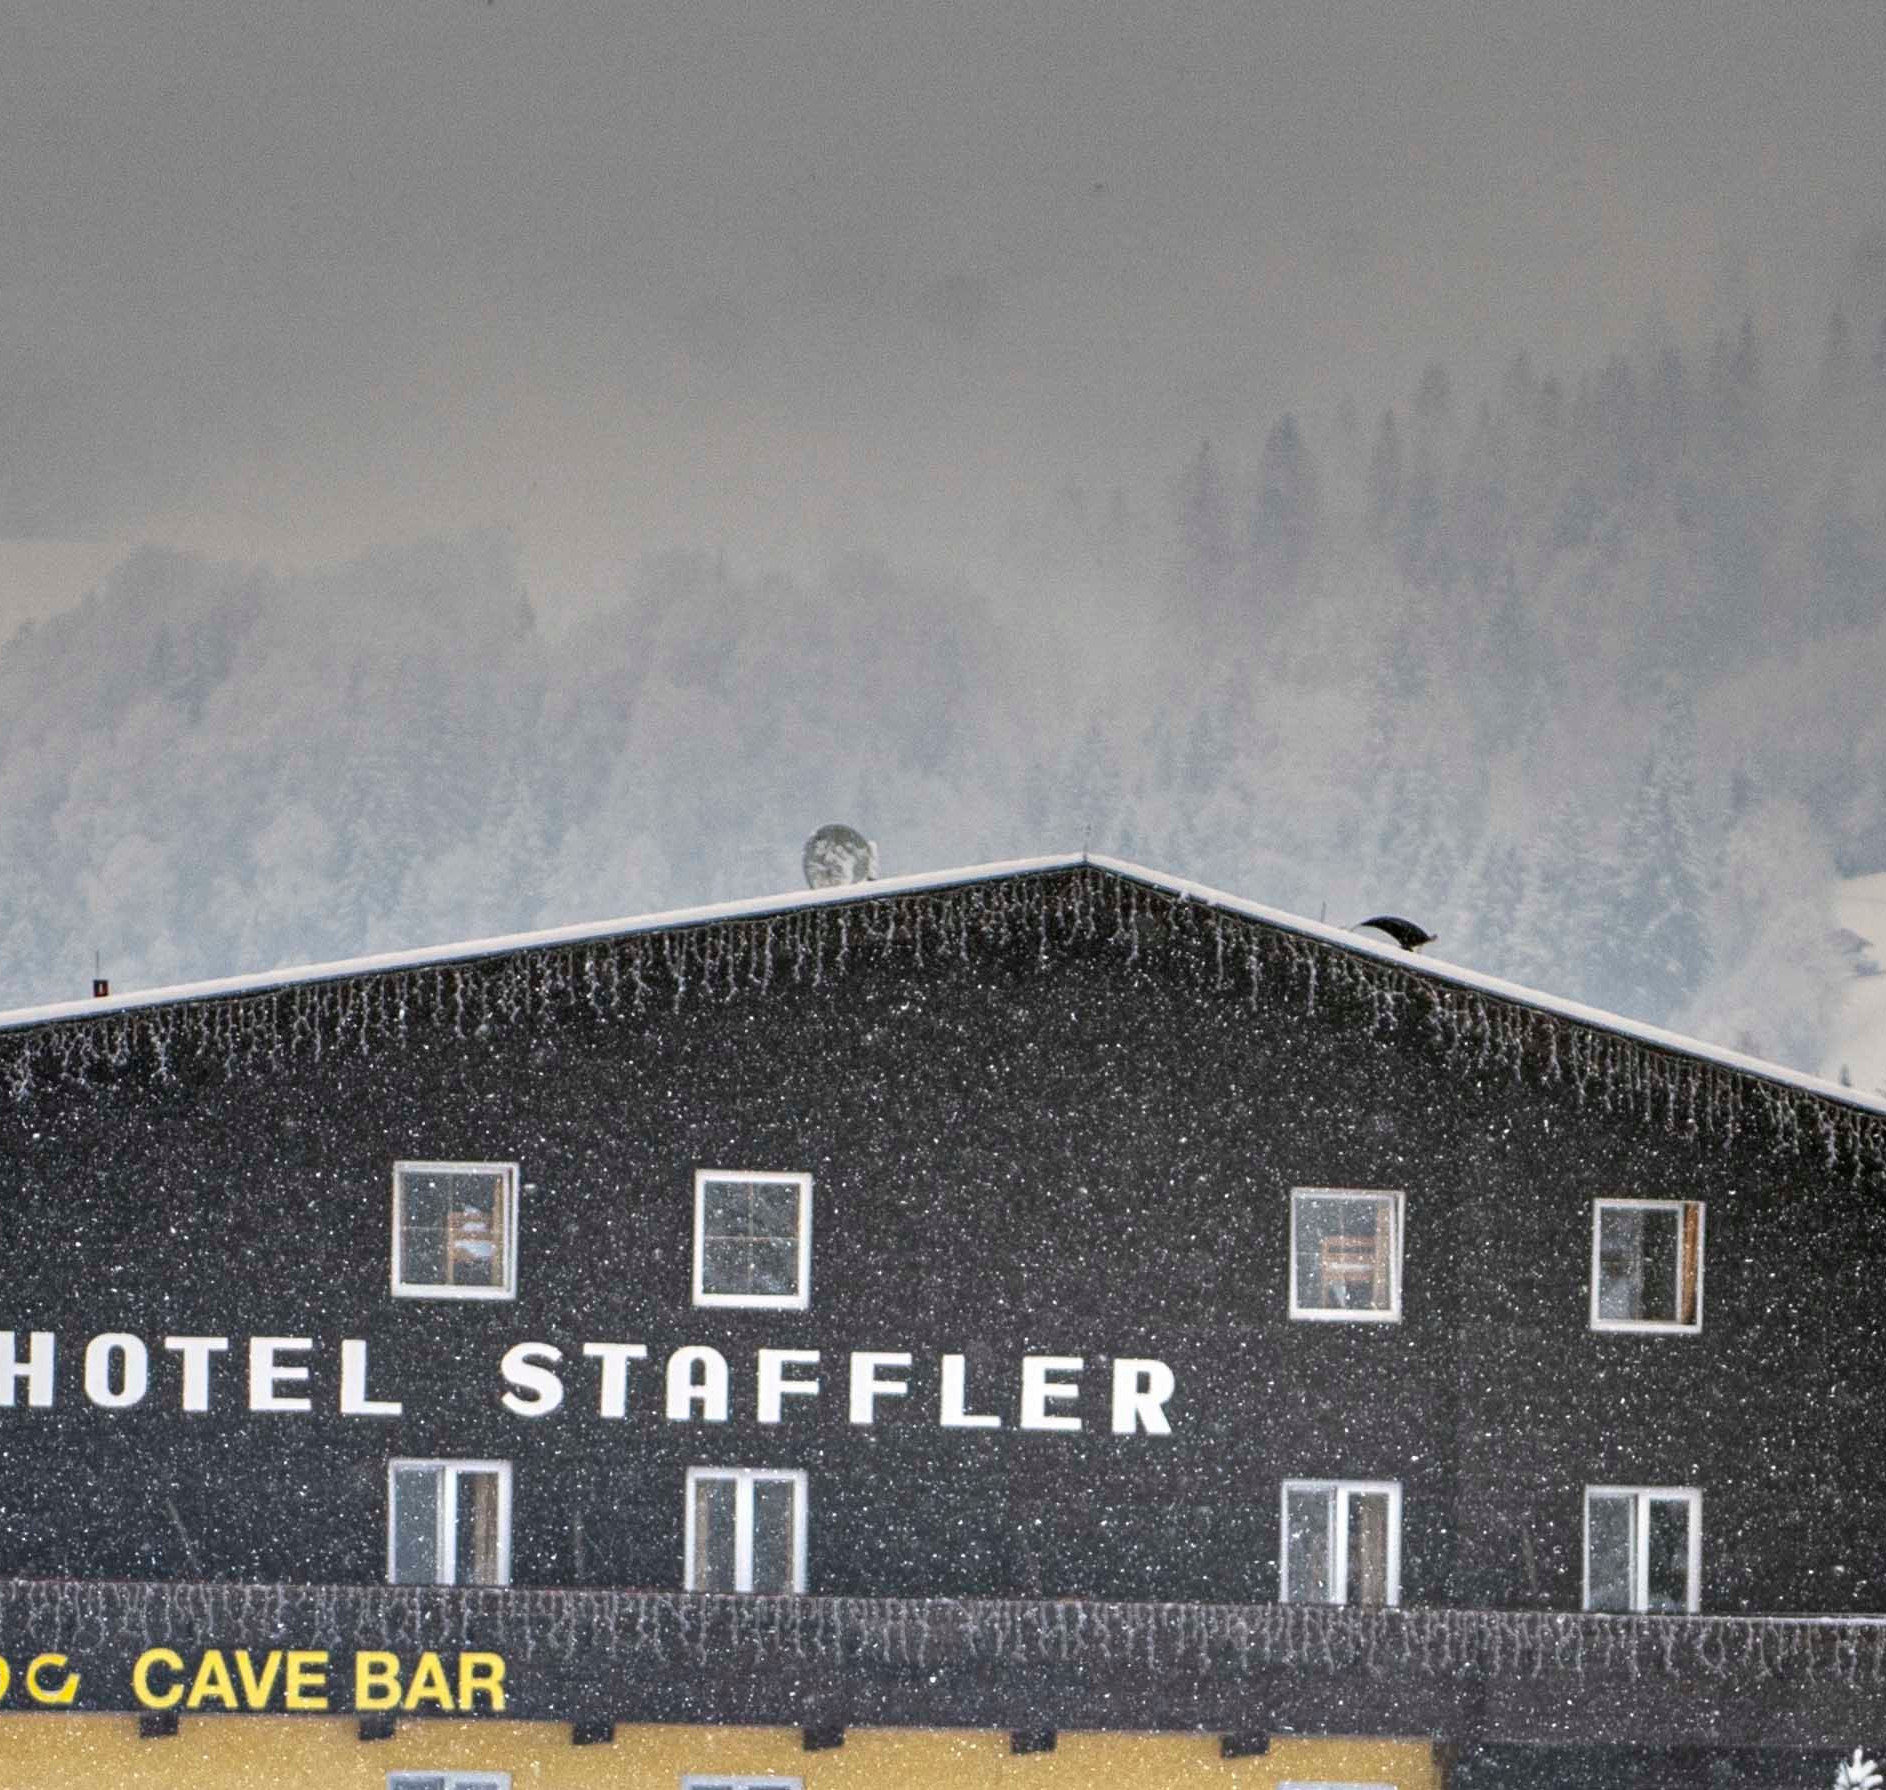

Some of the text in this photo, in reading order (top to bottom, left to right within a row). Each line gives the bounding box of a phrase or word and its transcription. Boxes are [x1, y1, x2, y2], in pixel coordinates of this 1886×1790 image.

[500, 1342, 1175, 1435] STAFFLER
[132, 1647, 329, 1710] CAVE
[355, 1649, 506, 1710] BAR
